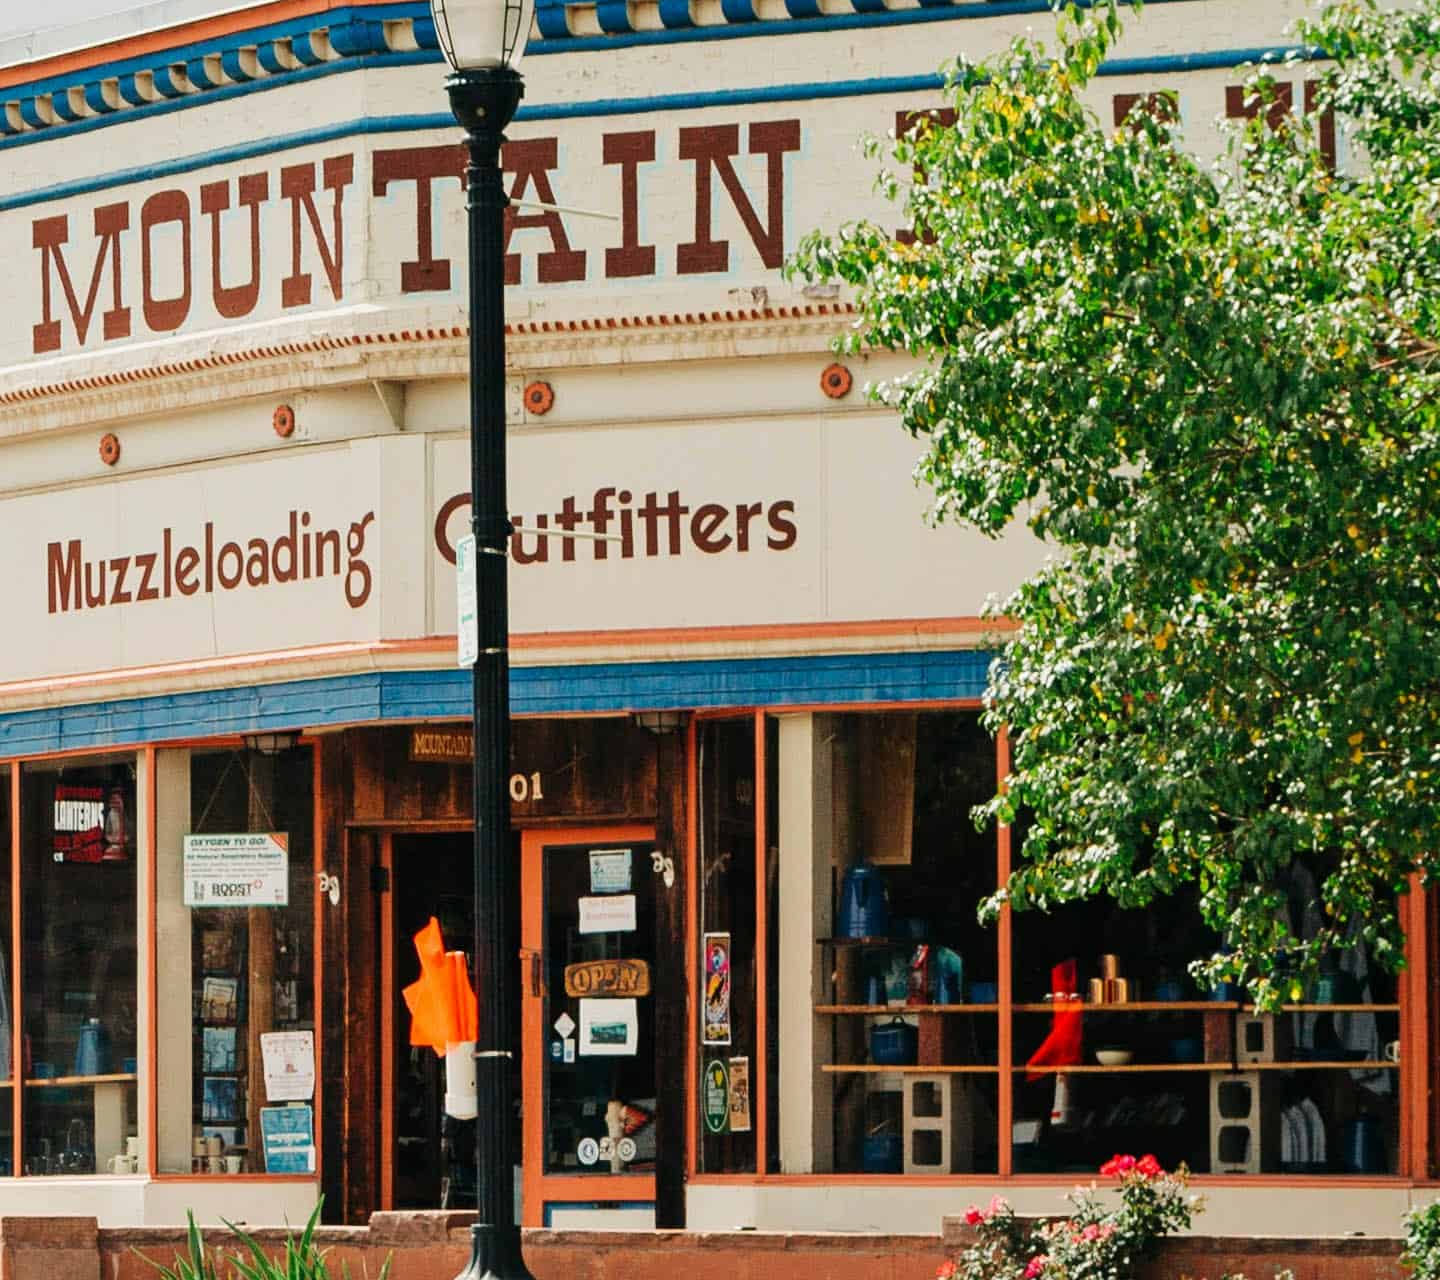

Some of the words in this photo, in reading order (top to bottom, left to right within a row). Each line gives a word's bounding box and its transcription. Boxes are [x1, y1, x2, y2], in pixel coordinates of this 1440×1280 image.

[31, 118, 802, 355] MOUNTAIN
[46, 508, 375, 615] Muzzleloading
[415, 733, 469, 756] MOUNTAIN
[573, 967, 640, 992] OPEN
